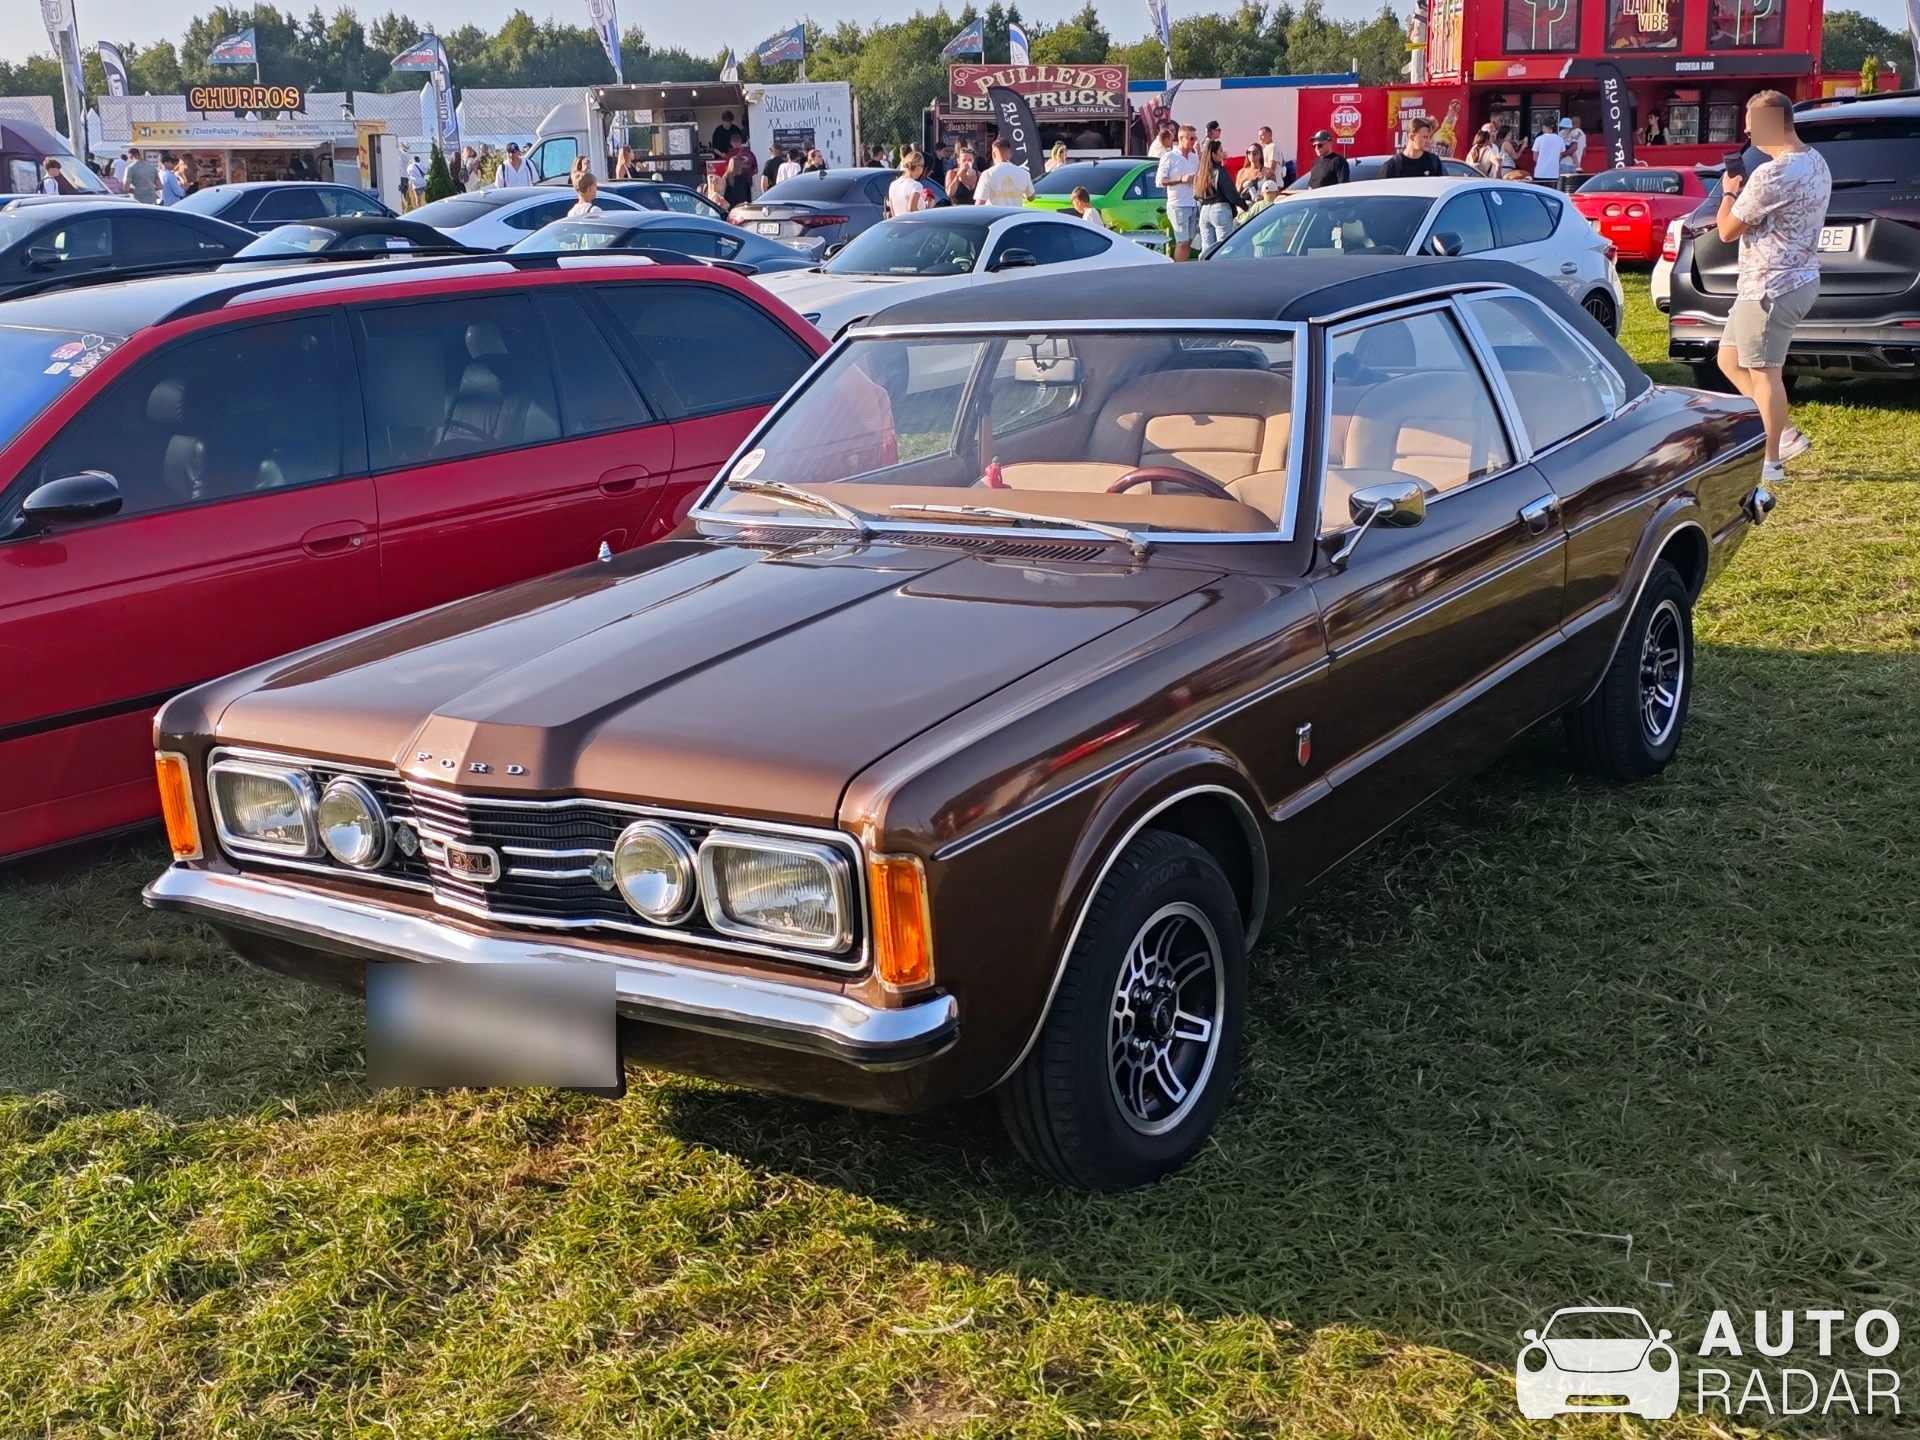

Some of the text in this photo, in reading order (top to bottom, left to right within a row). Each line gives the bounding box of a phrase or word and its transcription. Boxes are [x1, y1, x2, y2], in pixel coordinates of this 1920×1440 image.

[1638, 13, 1669, 32] VIBE
[1675, 61, 1715, 71] BODEGA BAR
[973, 66, 1097, 94] PULLED
[190, 86, 300, 109] CHURROS
[956, 89, 1121, 112] BE TRUCK
[793, 115, 822, 129] OGNIU!
[1334, 112, 1358, 123] STOP
[1398, 109, 1426, 119] THE BEER
[415, 751, 526, 776] FORD
